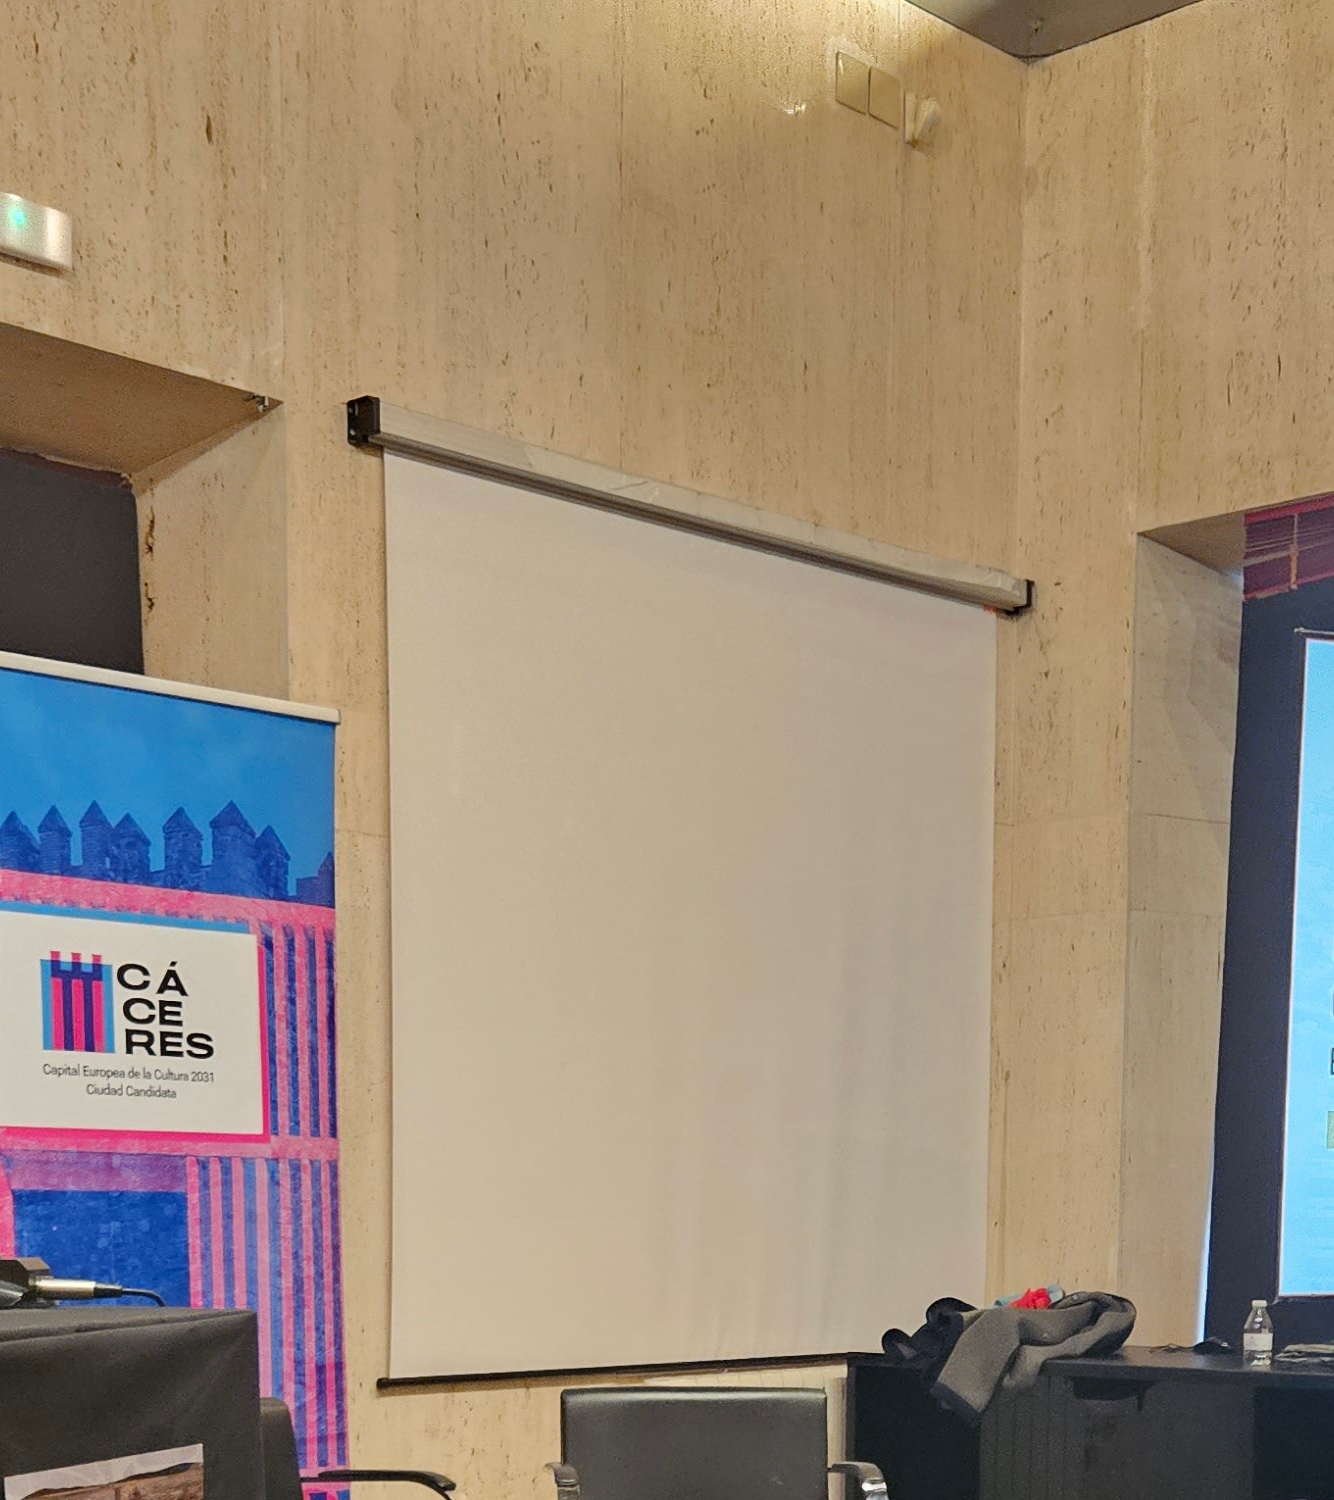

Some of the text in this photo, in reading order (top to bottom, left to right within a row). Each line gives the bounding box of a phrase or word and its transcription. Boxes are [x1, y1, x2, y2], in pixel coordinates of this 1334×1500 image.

[42, 1063, 215, 1083] Capital Europea de la Cultura 2031
[86, 1084, 177, 1099] Ciudad Candidata
